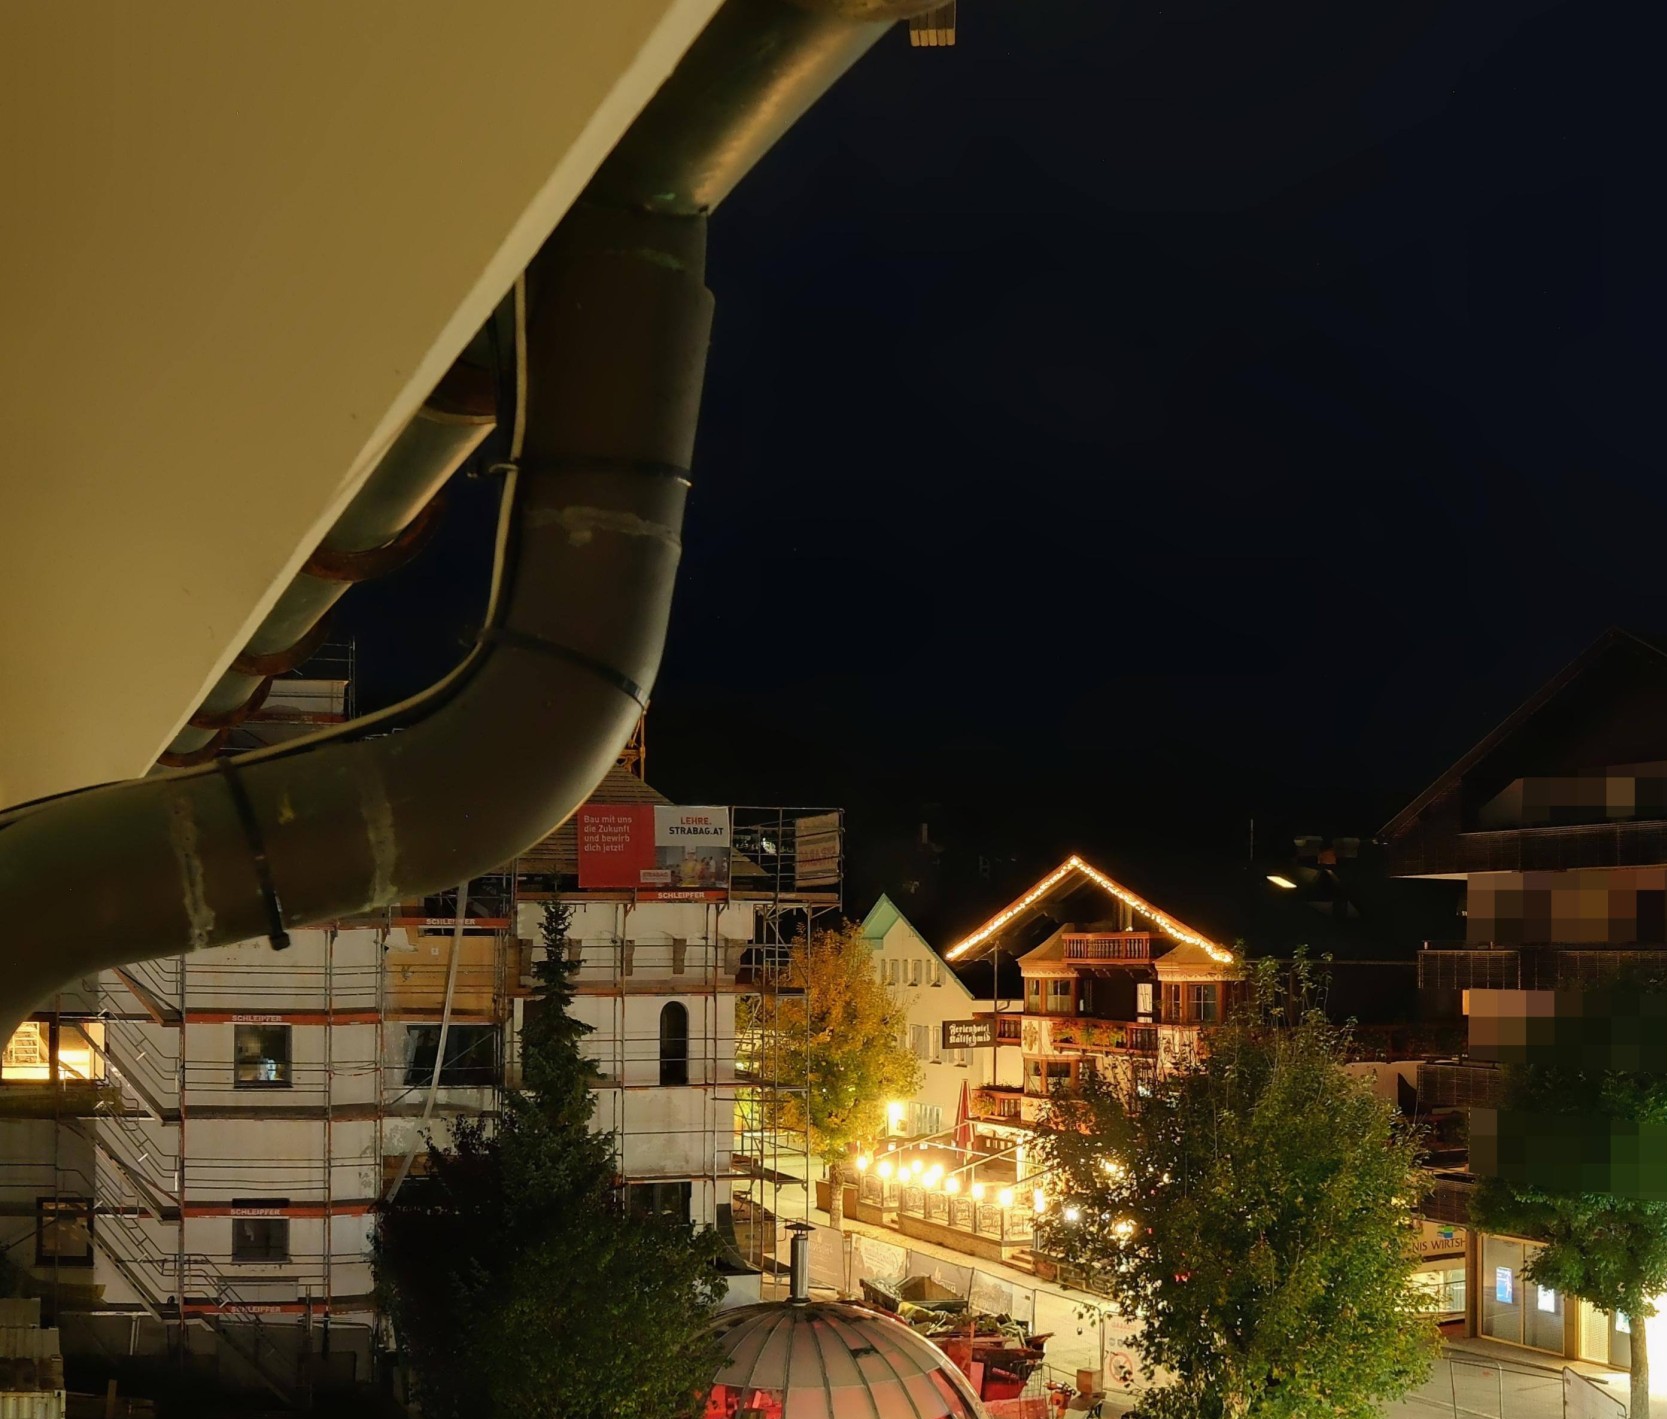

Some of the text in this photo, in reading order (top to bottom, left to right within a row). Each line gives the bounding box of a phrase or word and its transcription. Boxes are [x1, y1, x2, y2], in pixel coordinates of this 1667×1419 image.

[584, 815, 633, 824] Bau mit uns
[680, 816, 713, 826] LEHRE.
[584, 824, 631, 833] die Zukunft
[669, 826, 724, 836] STRABAG.AT
[584, 833, 631, 843] und bewirb
[584, 843, 625, 854] dich jetzt!
[657, 890, 706, 899] SCHLEIPFER
[231, 1014, 283, 1023] SCHLEIPFER
[230, 1208, 281, 1216] SCHLEIPFER
